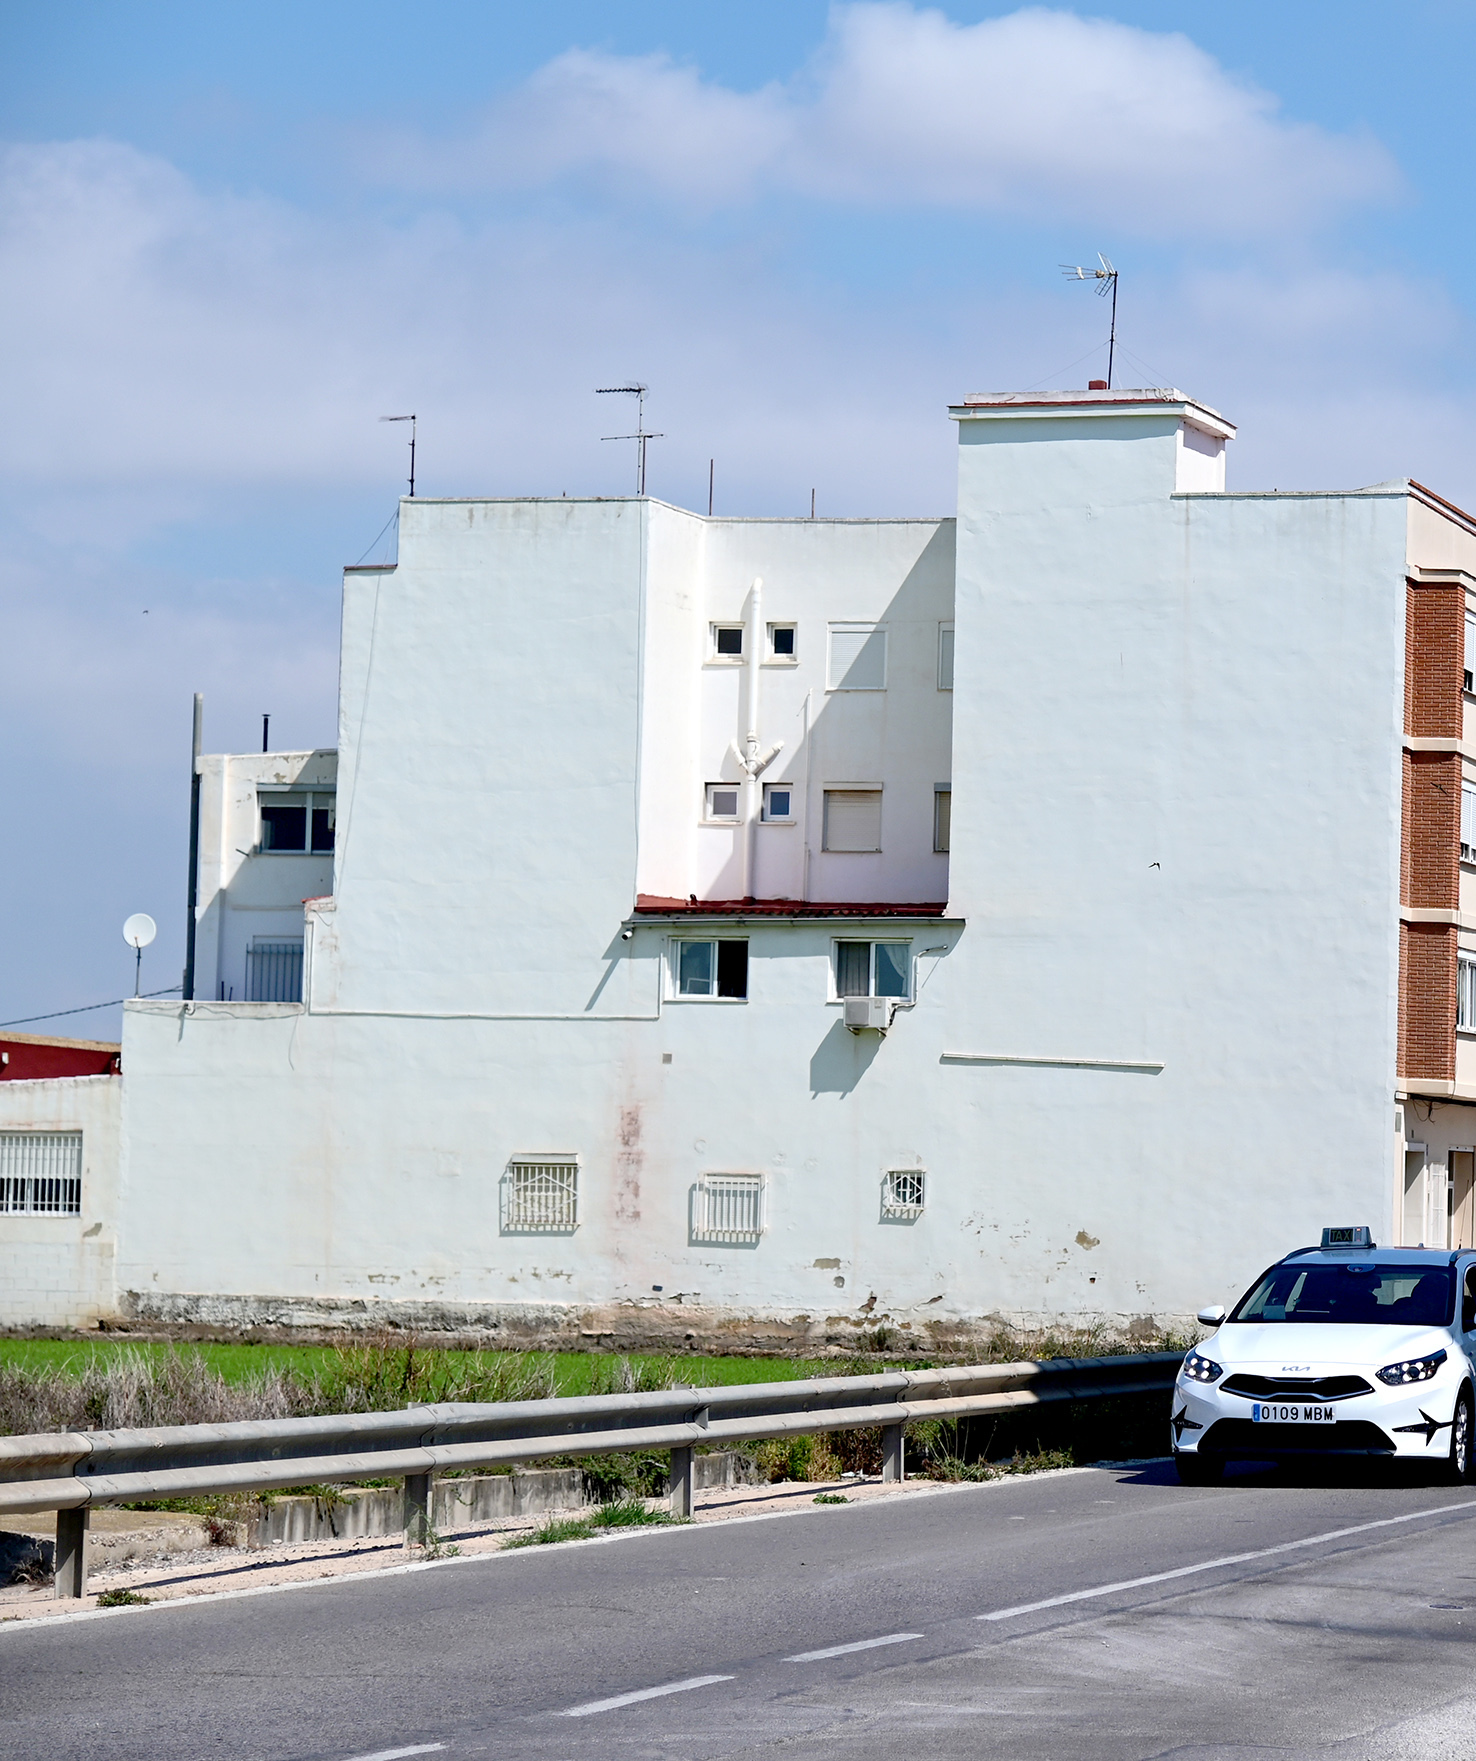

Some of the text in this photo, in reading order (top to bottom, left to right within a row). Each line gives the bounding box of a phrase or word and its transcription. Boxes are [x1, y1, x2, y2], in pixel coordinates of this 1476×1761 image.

[1331, 1230, 1353, 1241] TAXI
[1261, 1405, 1333, 1421] 0109 MBM
